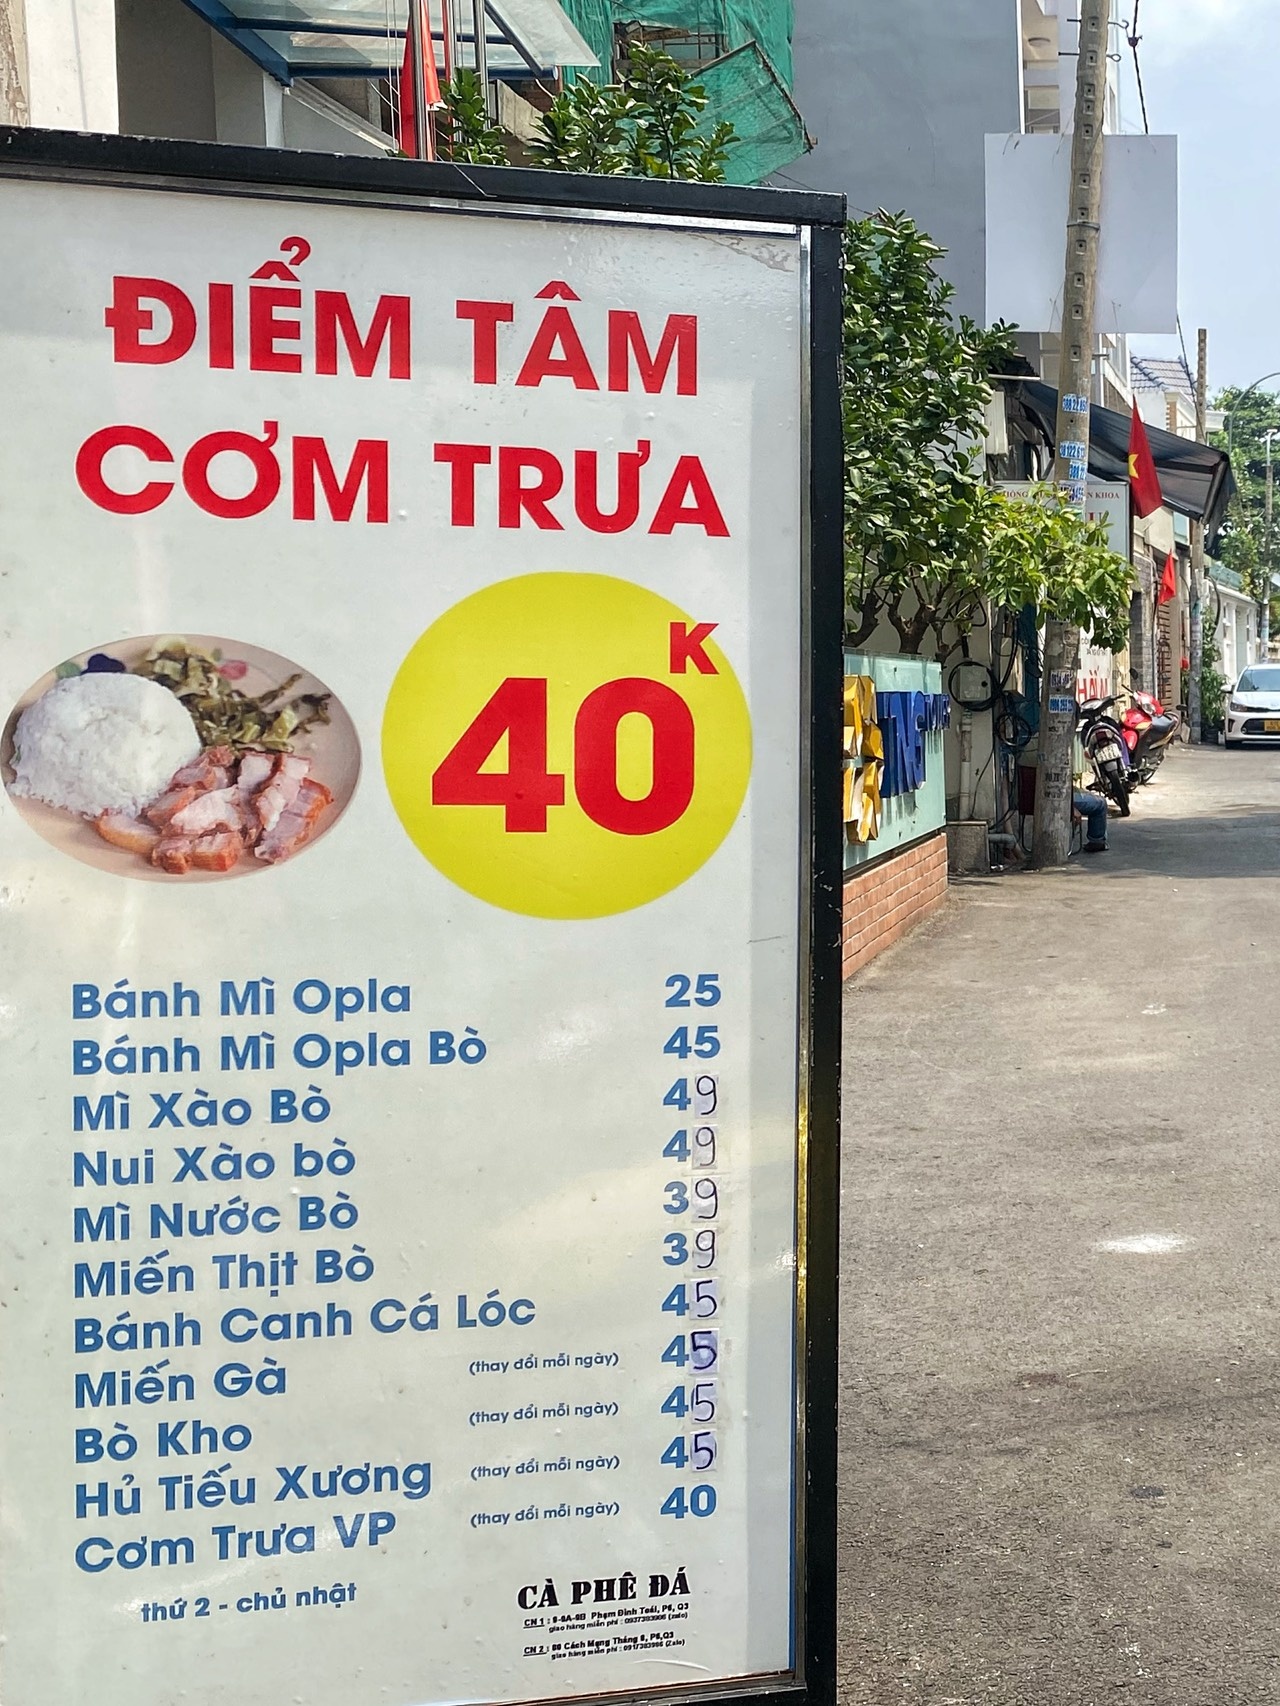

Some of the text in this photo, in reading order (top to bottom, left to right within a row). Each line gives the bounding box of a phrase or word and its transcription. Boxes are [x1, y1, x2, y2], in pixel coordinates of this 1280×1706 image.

[106, 237, 696, 395] ĐIỂM TÂM
[76, 421, 729, 536] CƠM TRƯA
[432, 677, 695, 835] 40
[73, 977, 410, 1021] Bánh Mì Opla
[665, 974, 721, 1007] 25
[73, 1027, 486, 1076] Bánh Mì Opla Bò
[664, 1026, 720, 1059] 45
[74, 1084, 330, 1131] Mì Xào Bò
[74, 1138, 355, 1187] Nui Xào bò
[74, 1191, 358, 1242] Mì Nước Bò
[75, 1244, 374, 1298] Miến Thịt Bò
[662, 1280, 717, 1317] 45
[75, 1290, 535, 1353] Bánh Canh Cá Lóc
[470, 1353, 618, 1375] (thay đổi mỗi ngày)
[661, 1331, 717, 1370] 45
[75, 1357, 286, 1408] Miến Gà
[470, 1402, 618, 1426] (thay đổi mỗi ngày)
[76, 1420, 252, 1463] Bò Kho
[661, 1432, 716, 1469] 45
[471, 1456, 619, 1480] (thay đổi mỗi ngày)
[76, 1463, 431, 1518] Hủ Tiếu Xương
[660, 1484, 716, 1519] 40
[471, 1502, 619, 1528] (thay đổi mỗi ngày)
[75, 1512, 396, 1573] Cơm Trưa VP
[141, 1598, 187, 1622] thứ
[195, 1598, 210, 1616] 2
[237, 1587, 286, 1612] chủ
[296, 1583, 356, 1608] nhật
[518, 1567, 690, 1609] CÀ PHÊ ĐÁ
[524, 1619, 538, 1627] CN
[591, 1610, 615, 1620] Phạm
[549, 1625, 565, 1633] giao
[566, 1621, 585, 1630] hàng
[564, 1641, 586, 1650] Cách
